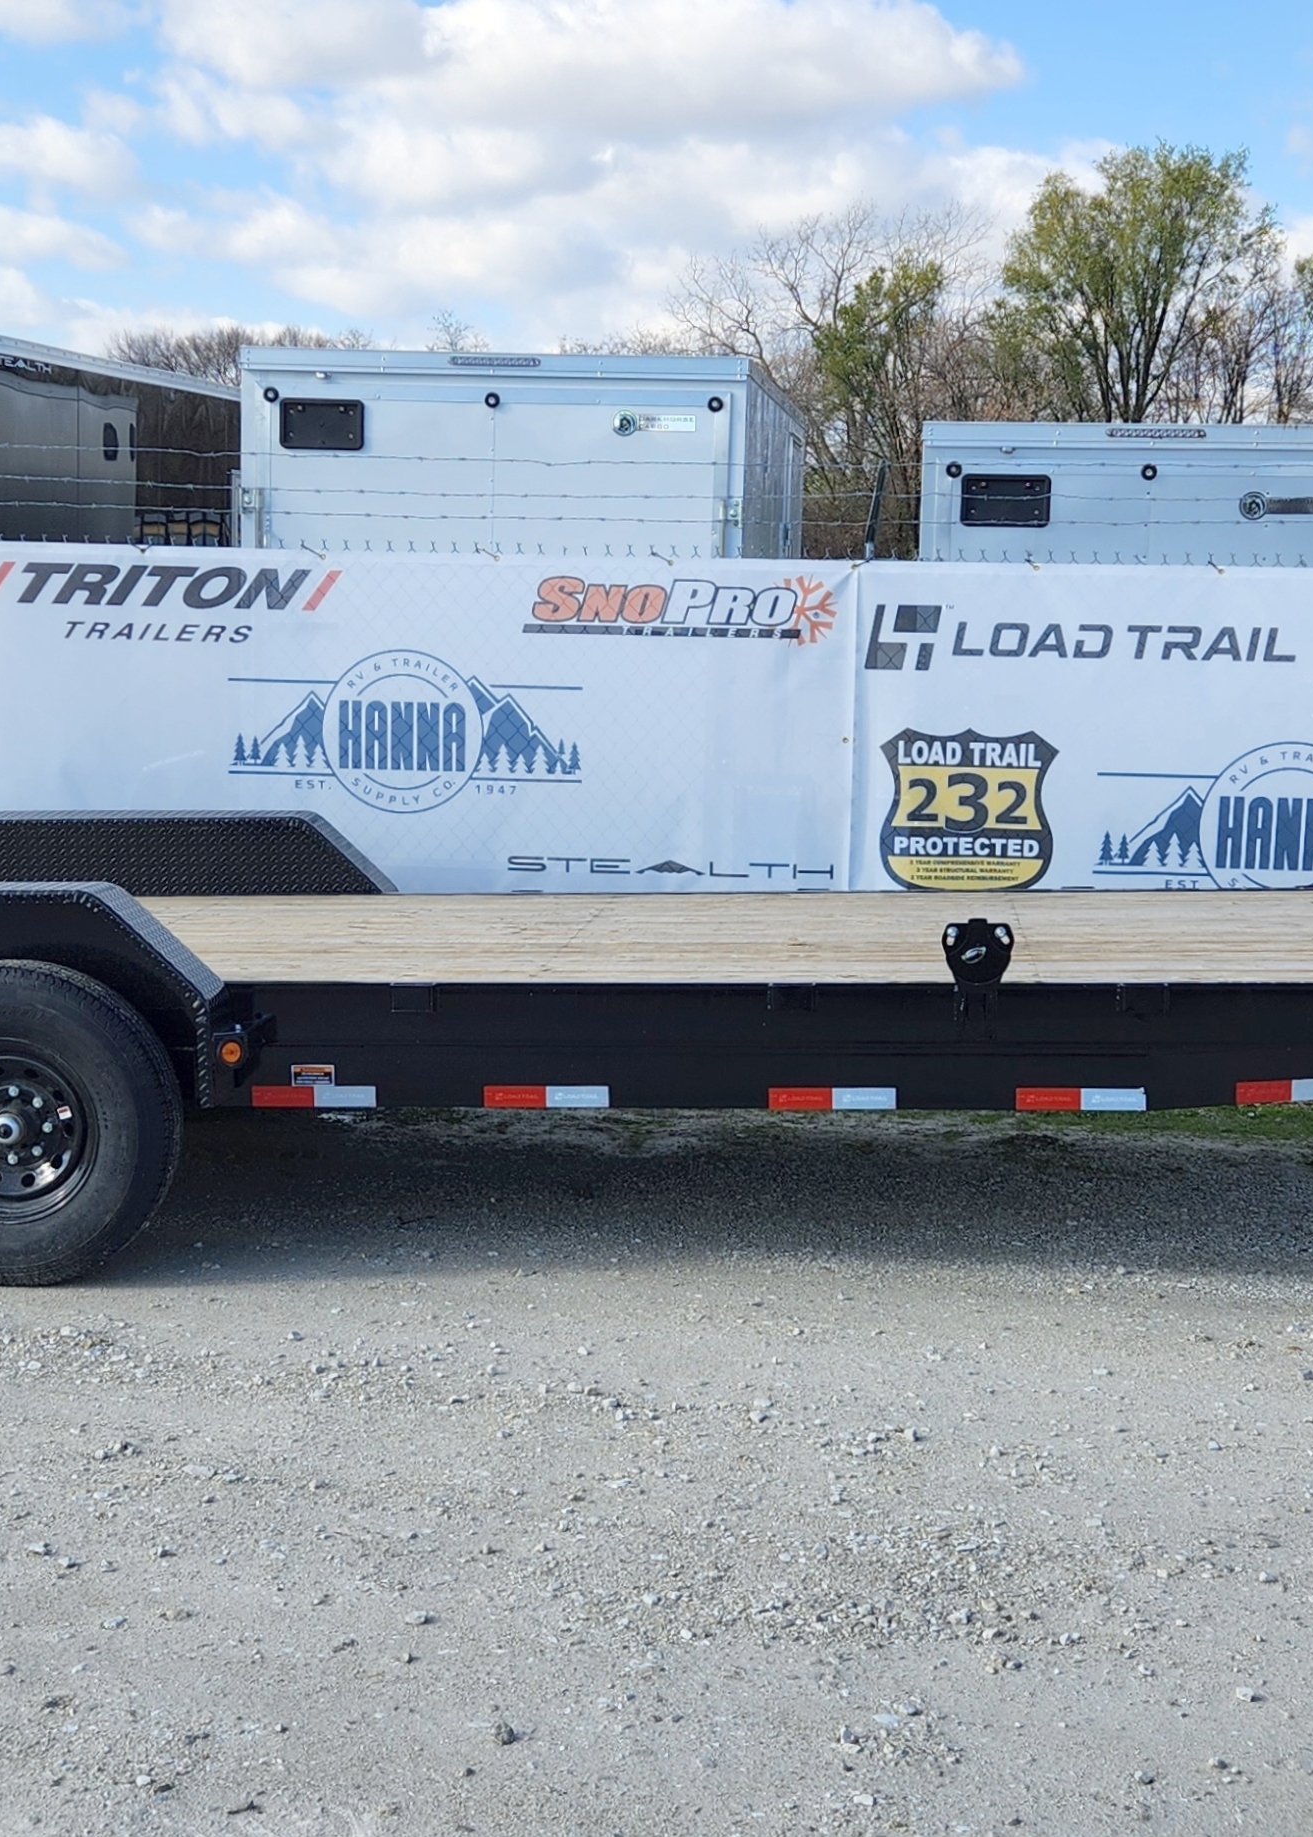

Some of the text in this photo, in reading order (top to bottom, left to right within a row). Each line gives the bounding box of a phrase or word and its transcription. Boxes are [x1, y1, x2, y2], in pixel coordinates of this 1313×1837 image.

[18, 564, 311, 610] TRITON
[64, 620, 254, 644] TRAILERS
[621, 626, 783, 639] TRAILERS
[952, 621, 1296, 662] LOAD TRAIL
[347, 658, 459, 692] RV & TRAILER
[339, 700, 466, 772] HANNA
[898, 740, 1041, 767] LOAD TRAIL
[1229, 764, 1249, 785] RV
[1259, 755, 1269, 766] &
[295, 779, 332, 791] EST.
[351, 777, 420, 806] SUPPLY
[475, 784, 517, 796] 1947
[906, 772, 1028, 831] 232
[894, 836, 1039, 857] PROTECTED
[507, 856, 834, 880] STEALTH
